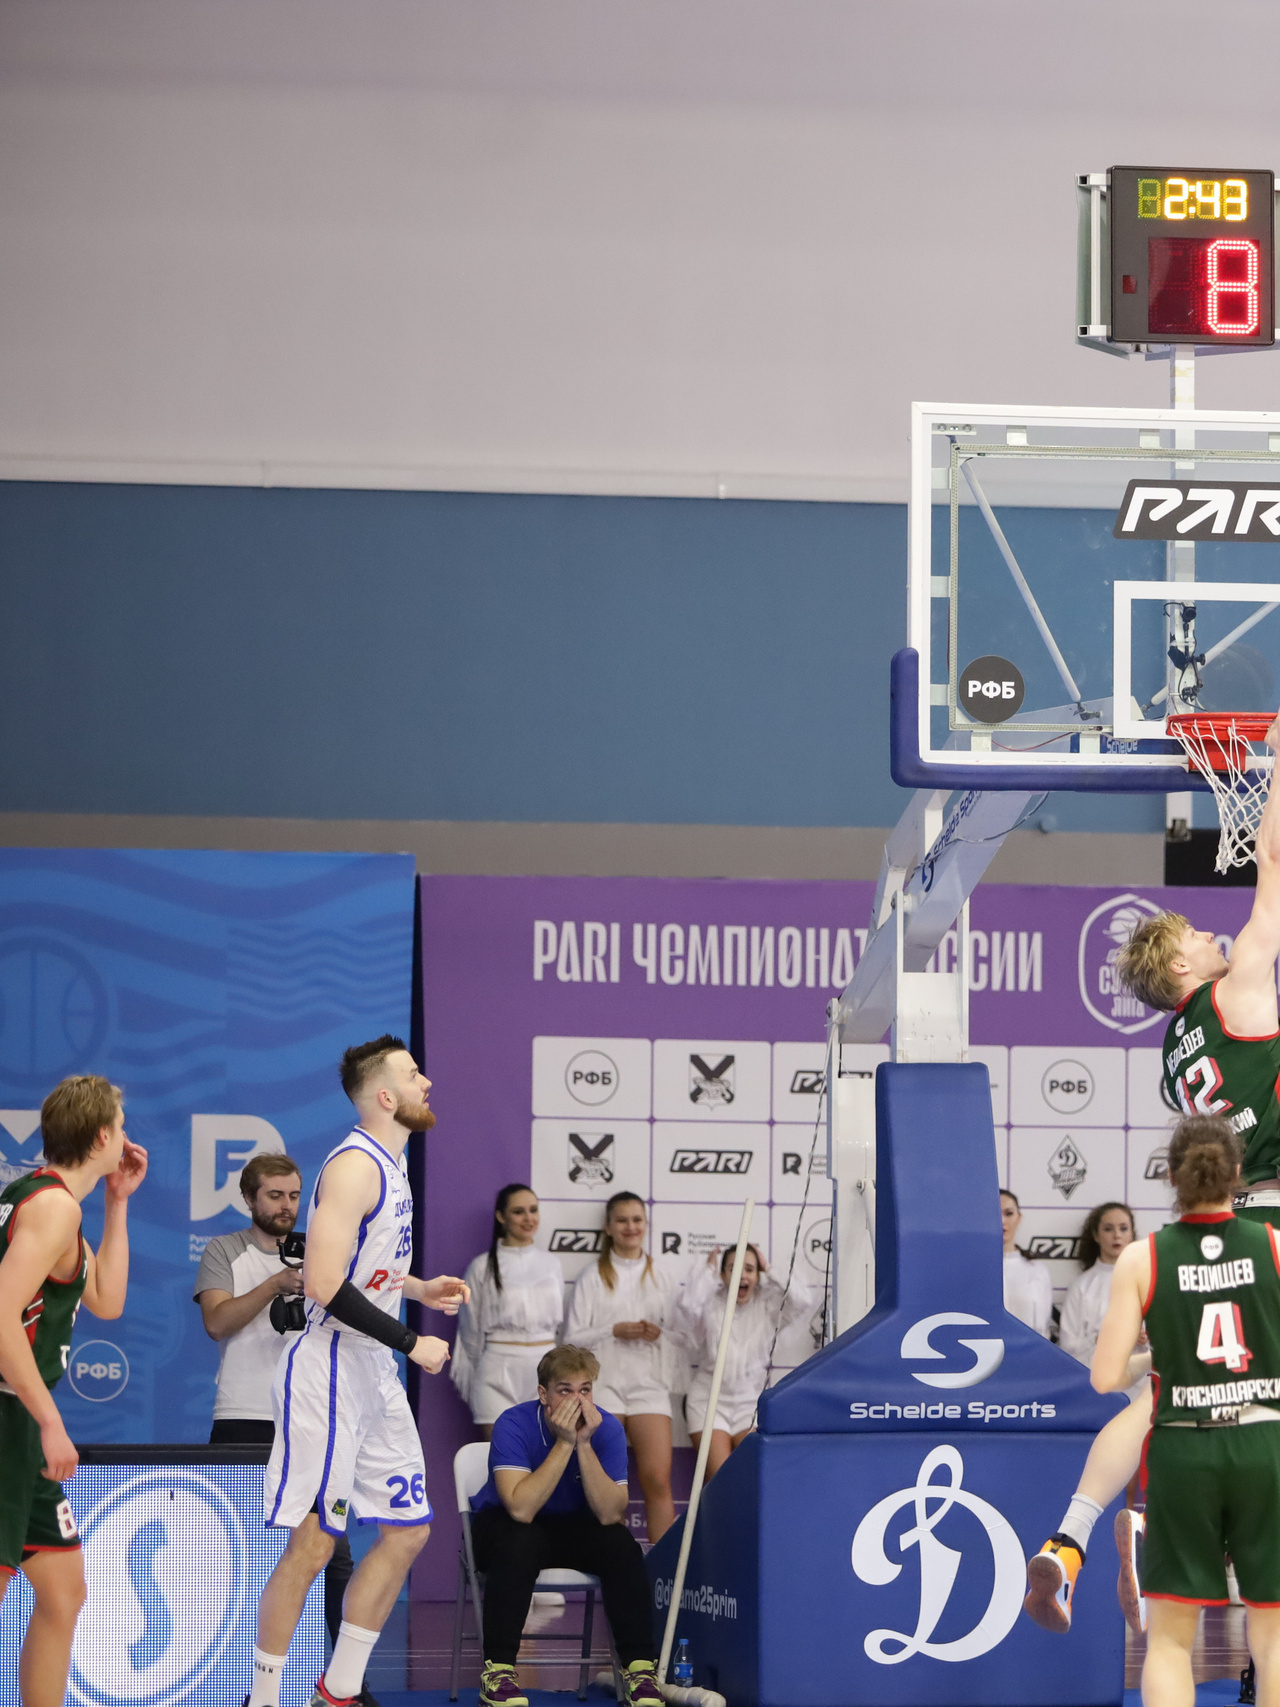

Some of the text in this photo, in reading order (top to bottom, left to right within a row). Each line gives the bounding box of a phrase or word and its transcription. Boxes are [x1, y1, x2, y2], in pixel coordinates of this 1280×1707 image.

[1164, 178, 1248, 221] 2:43
[1207, 239, 1259, 334] 8
[968, 680, 1016, 699] РФБ
[533, 920, 620, 983] PARI
[572, 1071, 612, 1086] РФБ
[1049, 1080, 1088, 1094] РФБ
[670, 1150, 751, 1173] PARI
[550, 1230, 603, 1252] PA
[1029, 1238, 1082, 1259] PA
[1177, 1257, 1256, 1292] ВЕДИЩЕВ
[1196, 1300, 1254, 1374] 4
[76, 1362, 122, 1380] РФБ
[849, 1401, 1057, 1423] Schelde Sports
[385, 1472, 425, 1509] 26
[56, 1498, 78, 1540] 8
[654, 1577, 738, 1622] @diamo25prim
